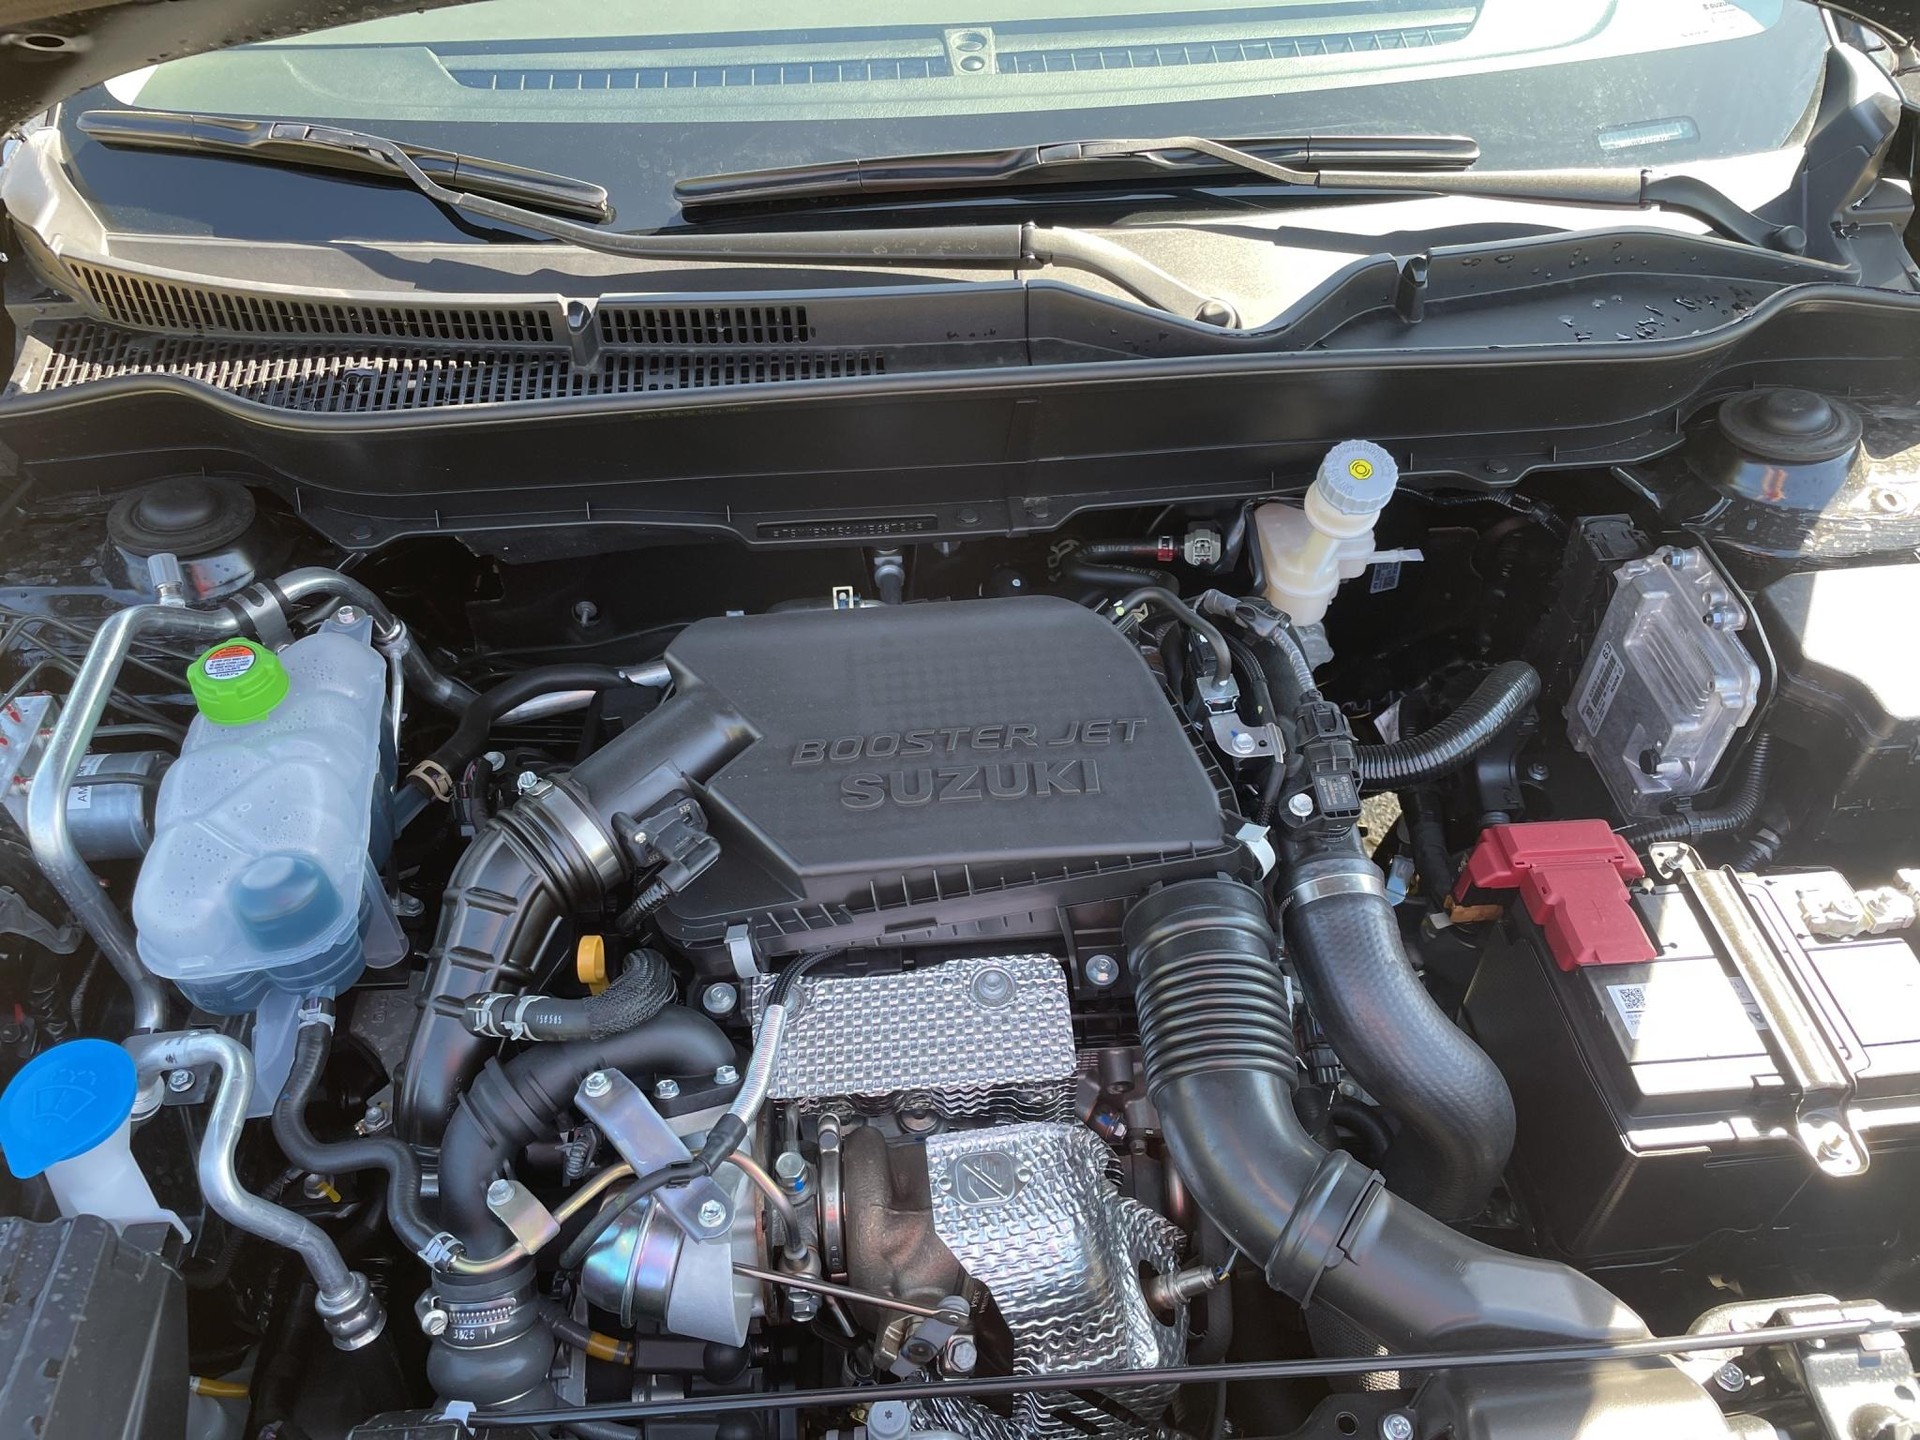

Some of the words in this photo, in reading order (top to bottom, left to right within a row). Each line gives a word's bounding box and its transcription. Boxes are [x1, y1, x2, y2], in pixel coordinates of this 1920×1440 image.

[792, 722, 1039, 767] BOOSTER
[1047, 718, 1147, 746] JET
[840, 759, 1101, 811] SUZUKI
